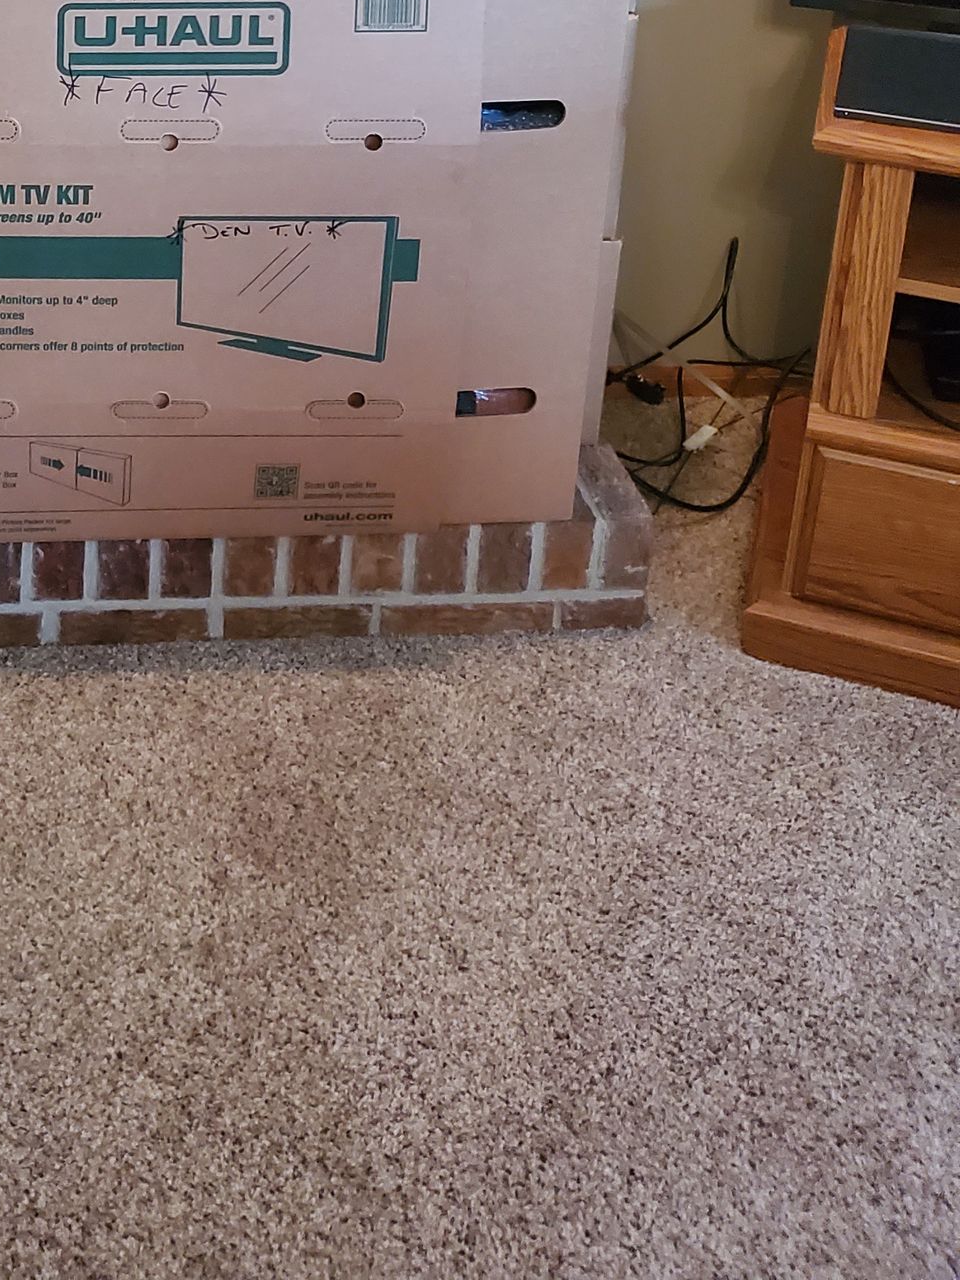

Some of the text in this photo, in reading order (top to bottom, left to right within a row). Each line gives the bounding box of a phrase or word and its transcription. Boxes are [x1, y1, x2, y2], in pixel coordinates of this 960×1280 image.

[20, 184, 52, 205] TV
[56, 184, 94, 205] KIT
[36, 214, 57, 225] up
[58, 212, 73, 223] to
[74, 211, 103, 224] 40"
[45, 297, 60, 307] up
[62, 296, 74, 306] to
[91, 295, 119, 308] deep
[0, 341, 40, 351] corners
[42, 341, 69, 352] offer
[80, 341, 115, 354] points
[116, 341, 128, 352] of
[129, 341, 185, 354] protection
[303, 511, 394, 522] uhaul.com
